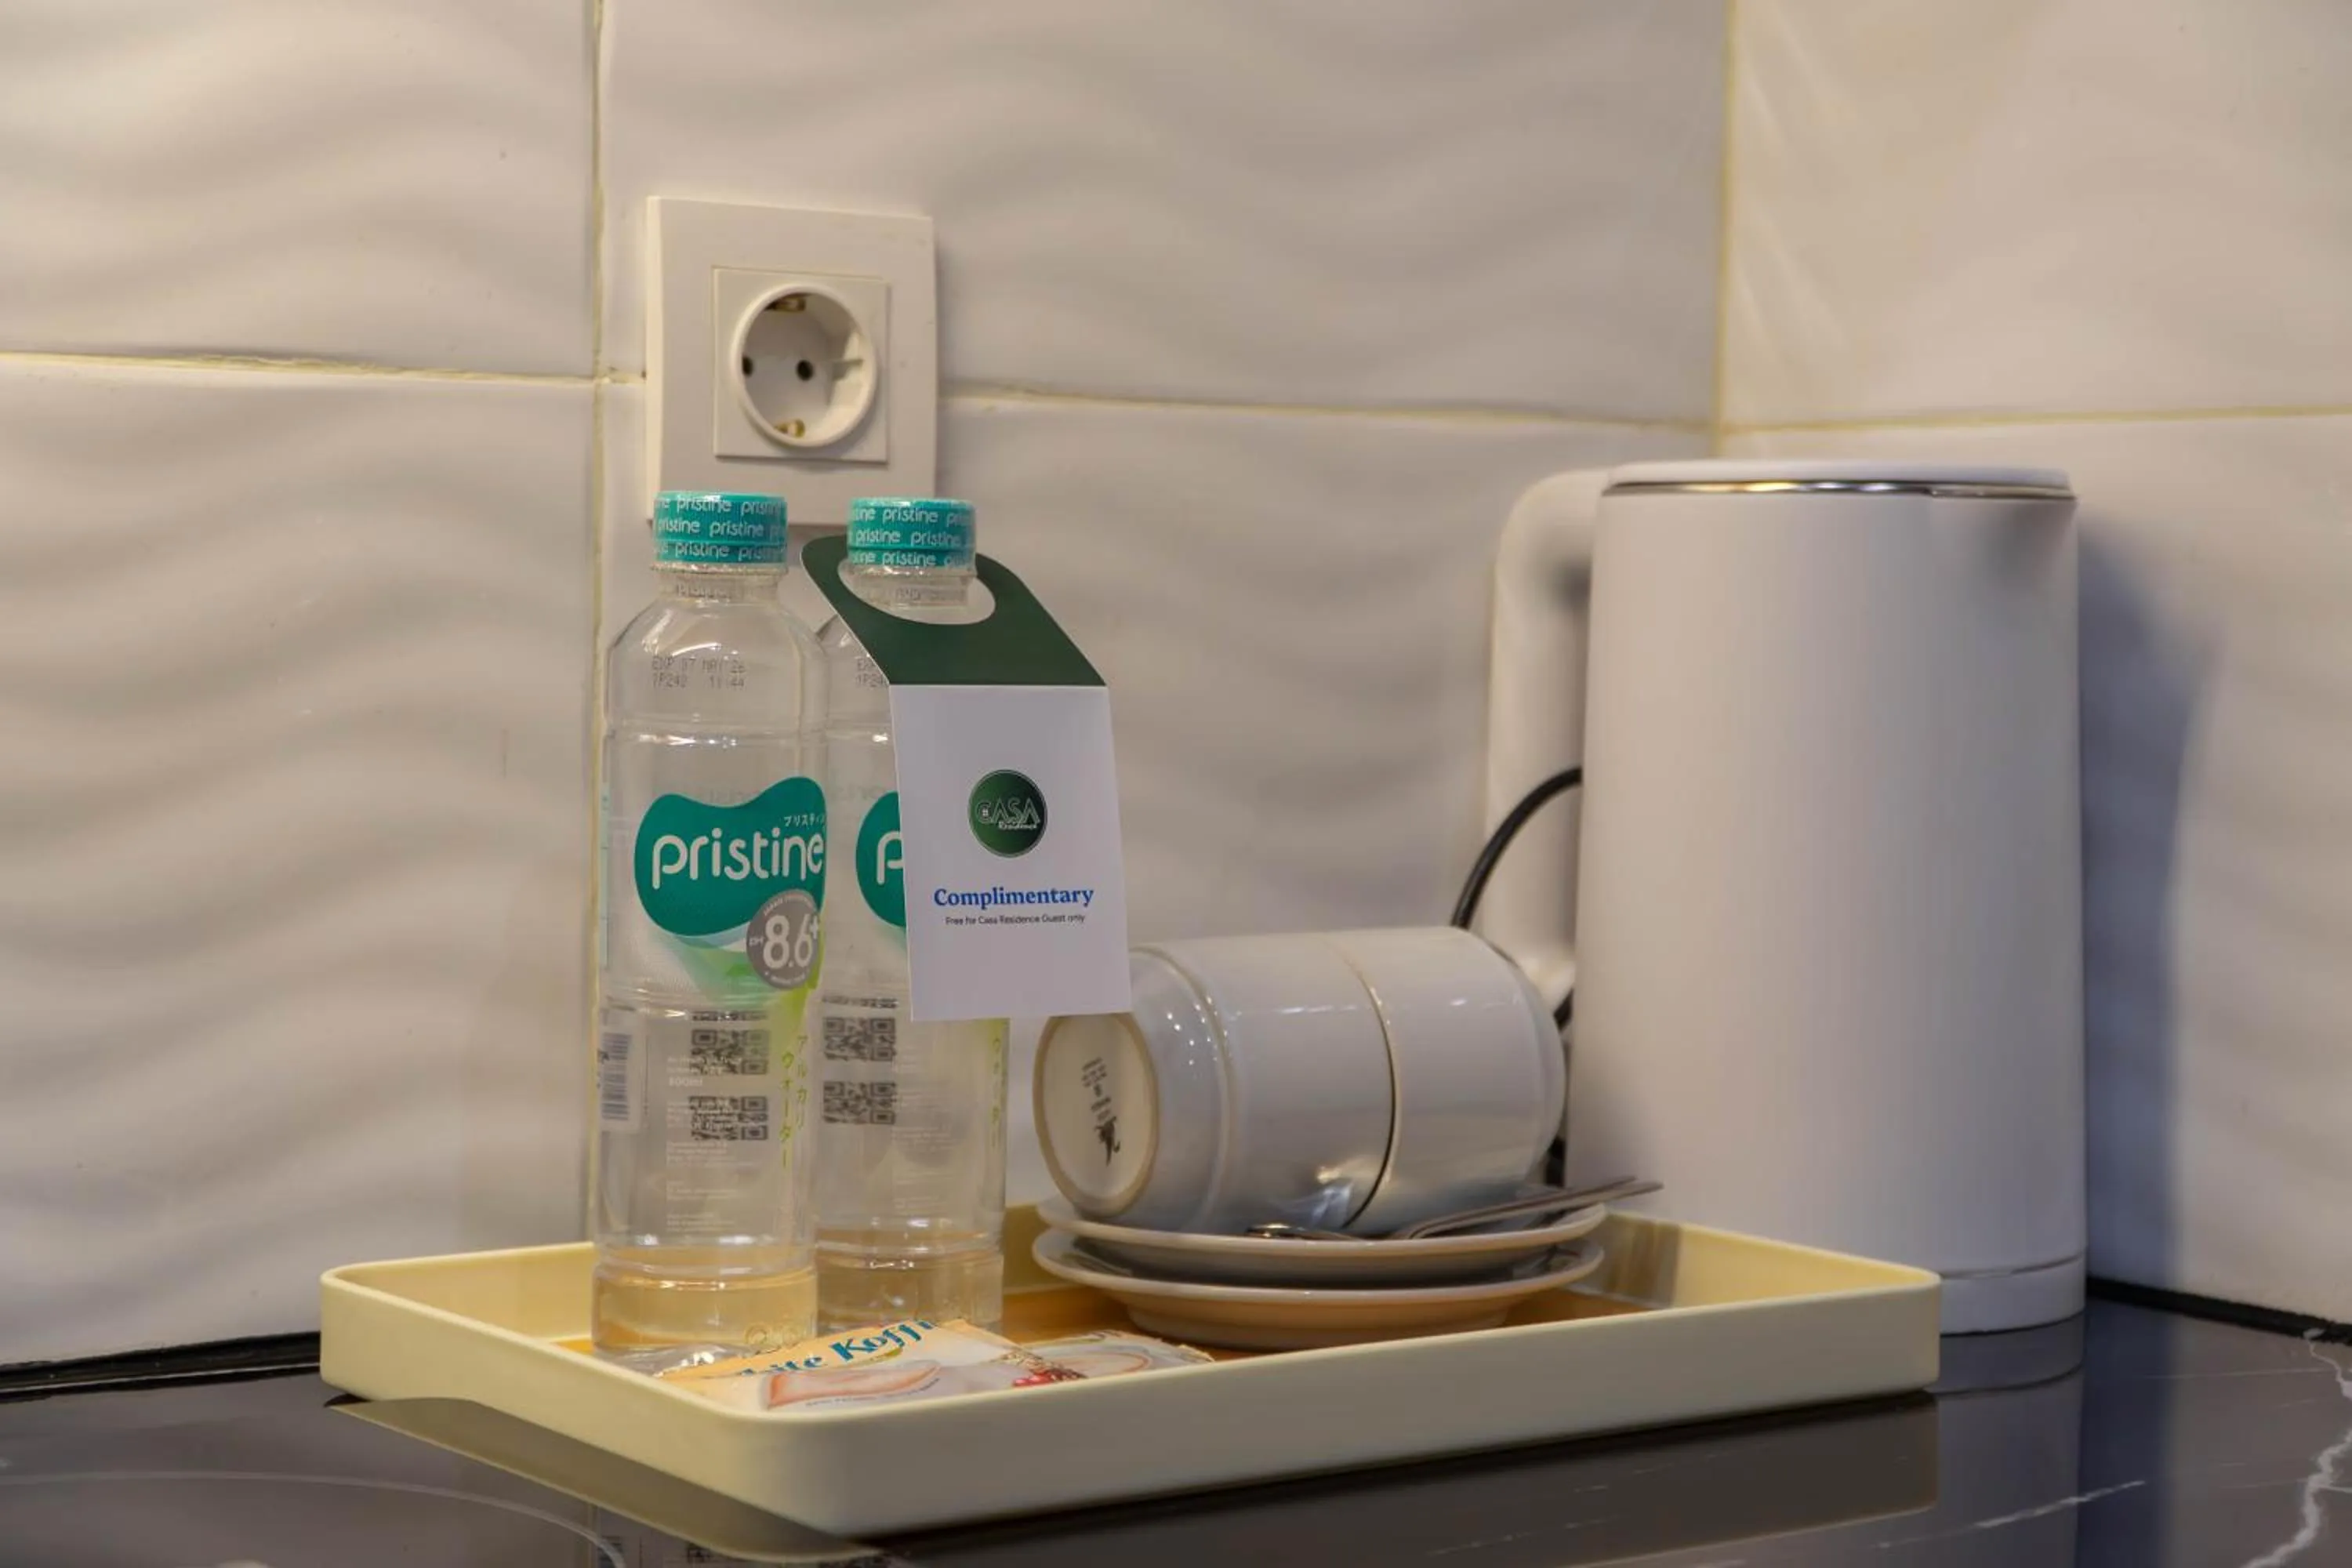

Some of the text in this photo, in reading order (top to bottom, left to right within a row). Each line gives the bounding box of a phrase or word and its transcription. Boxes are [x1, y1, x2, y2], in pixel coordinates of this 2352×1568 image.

[676, 494, 731, 513] pristine
[882, 507, 938, 524] pristine
[709, 520, 764, 538] pristine
[855, 529, 963, 547] pristine pristine
[674, 541, 730, 558] pristine
[881, 551, 937, 568] pristine
[975, 797, 1040, 825] CASA
[652, 827, 824, 891] pristine
[934, 887, 1094, 910] Complimentary
[946, 916, 964, 926] Free
[978, 915, 998, 925] Casa
[1000, 914, 1040, 924] Residence
